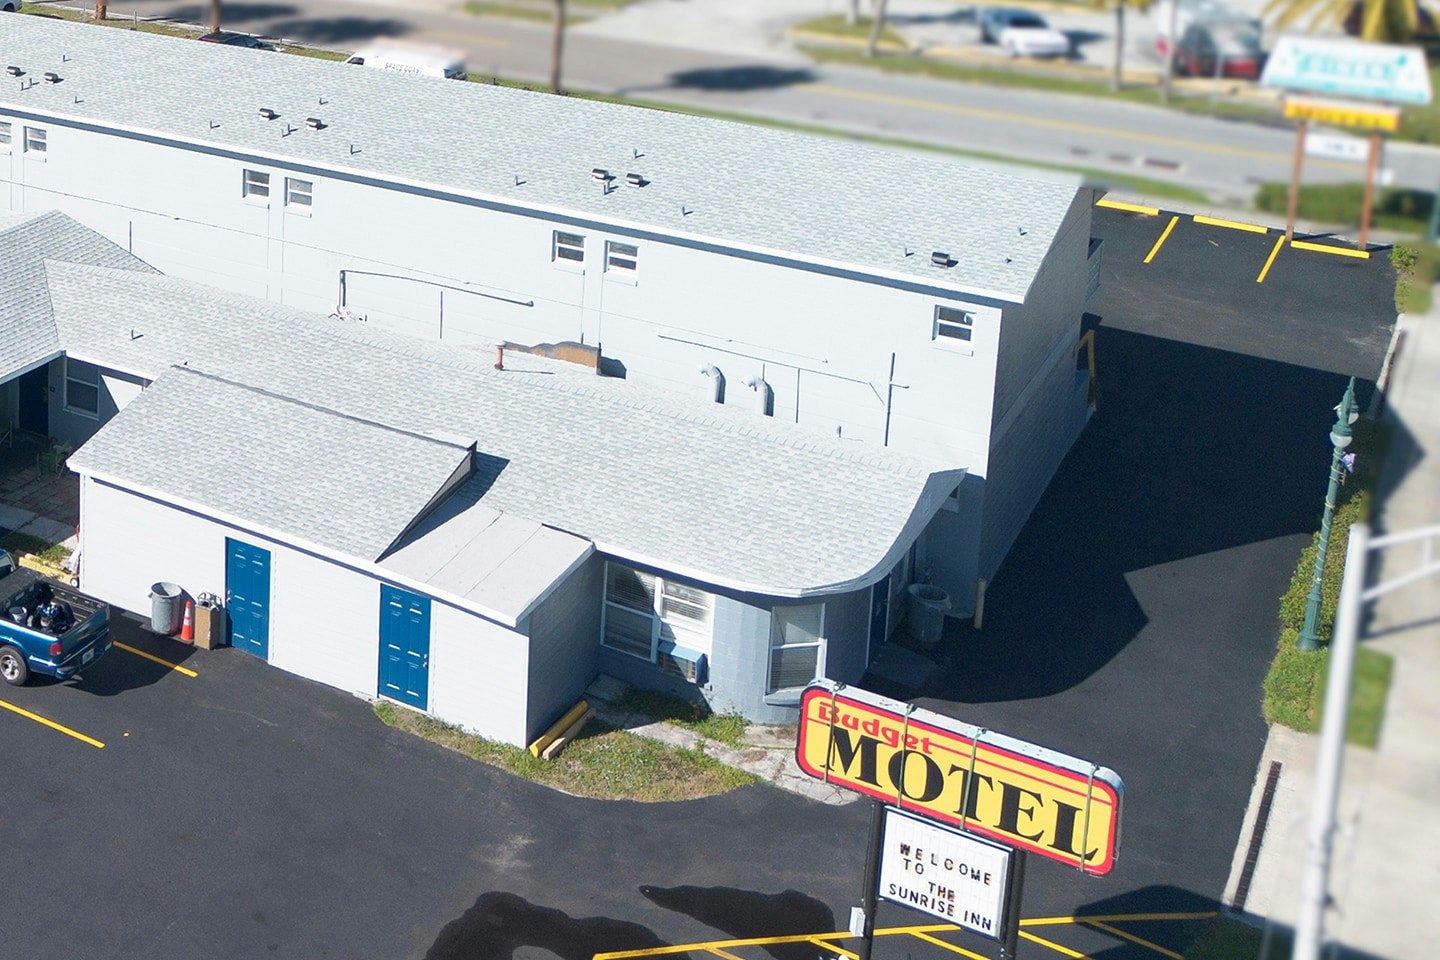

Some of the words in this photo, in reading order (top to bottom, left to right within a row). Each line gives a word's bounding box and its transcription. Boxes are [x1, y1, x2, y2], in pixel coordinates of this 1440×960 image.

[385, 62, 403, 72] SPACE
[818, 701, 932, 755] Budget
[820, 722, 1099, 862] MOTEL
[900, 842, 992, 886] WELCOME
[903, 858, 924, 875] TO
[889, 883, 955, 917] SUNRISE
[964, 910, 992, 931] INN
[928, 881, 955, 902] THE
